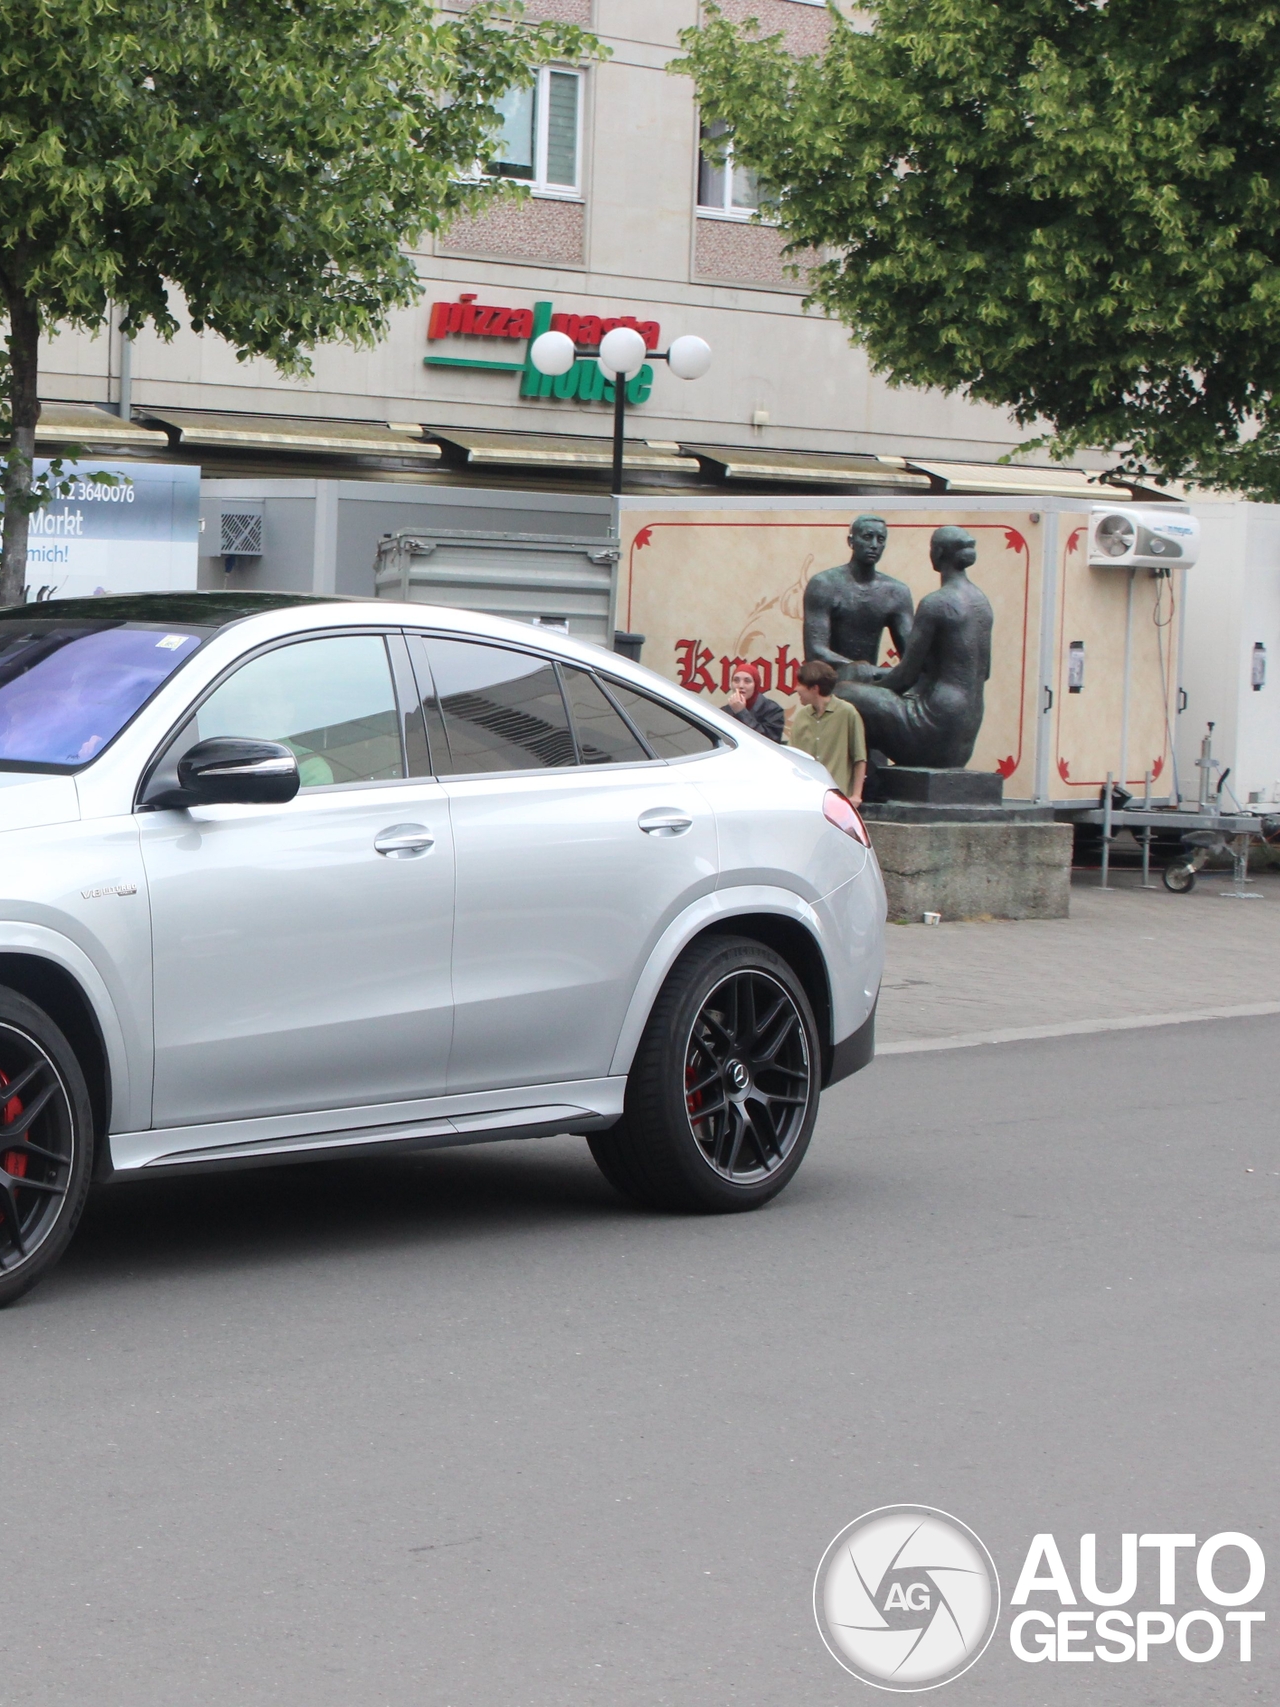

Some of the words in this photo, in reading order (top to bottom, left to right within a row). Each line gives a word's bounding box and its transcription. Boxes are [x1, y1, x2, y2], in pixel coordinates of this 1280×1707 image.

[427, 293, 534, 340] pizza
[56, 481, 75, 500] 12
[78, 482, 135, 503] 3640076
[27, 545, 68, 562] mich!
